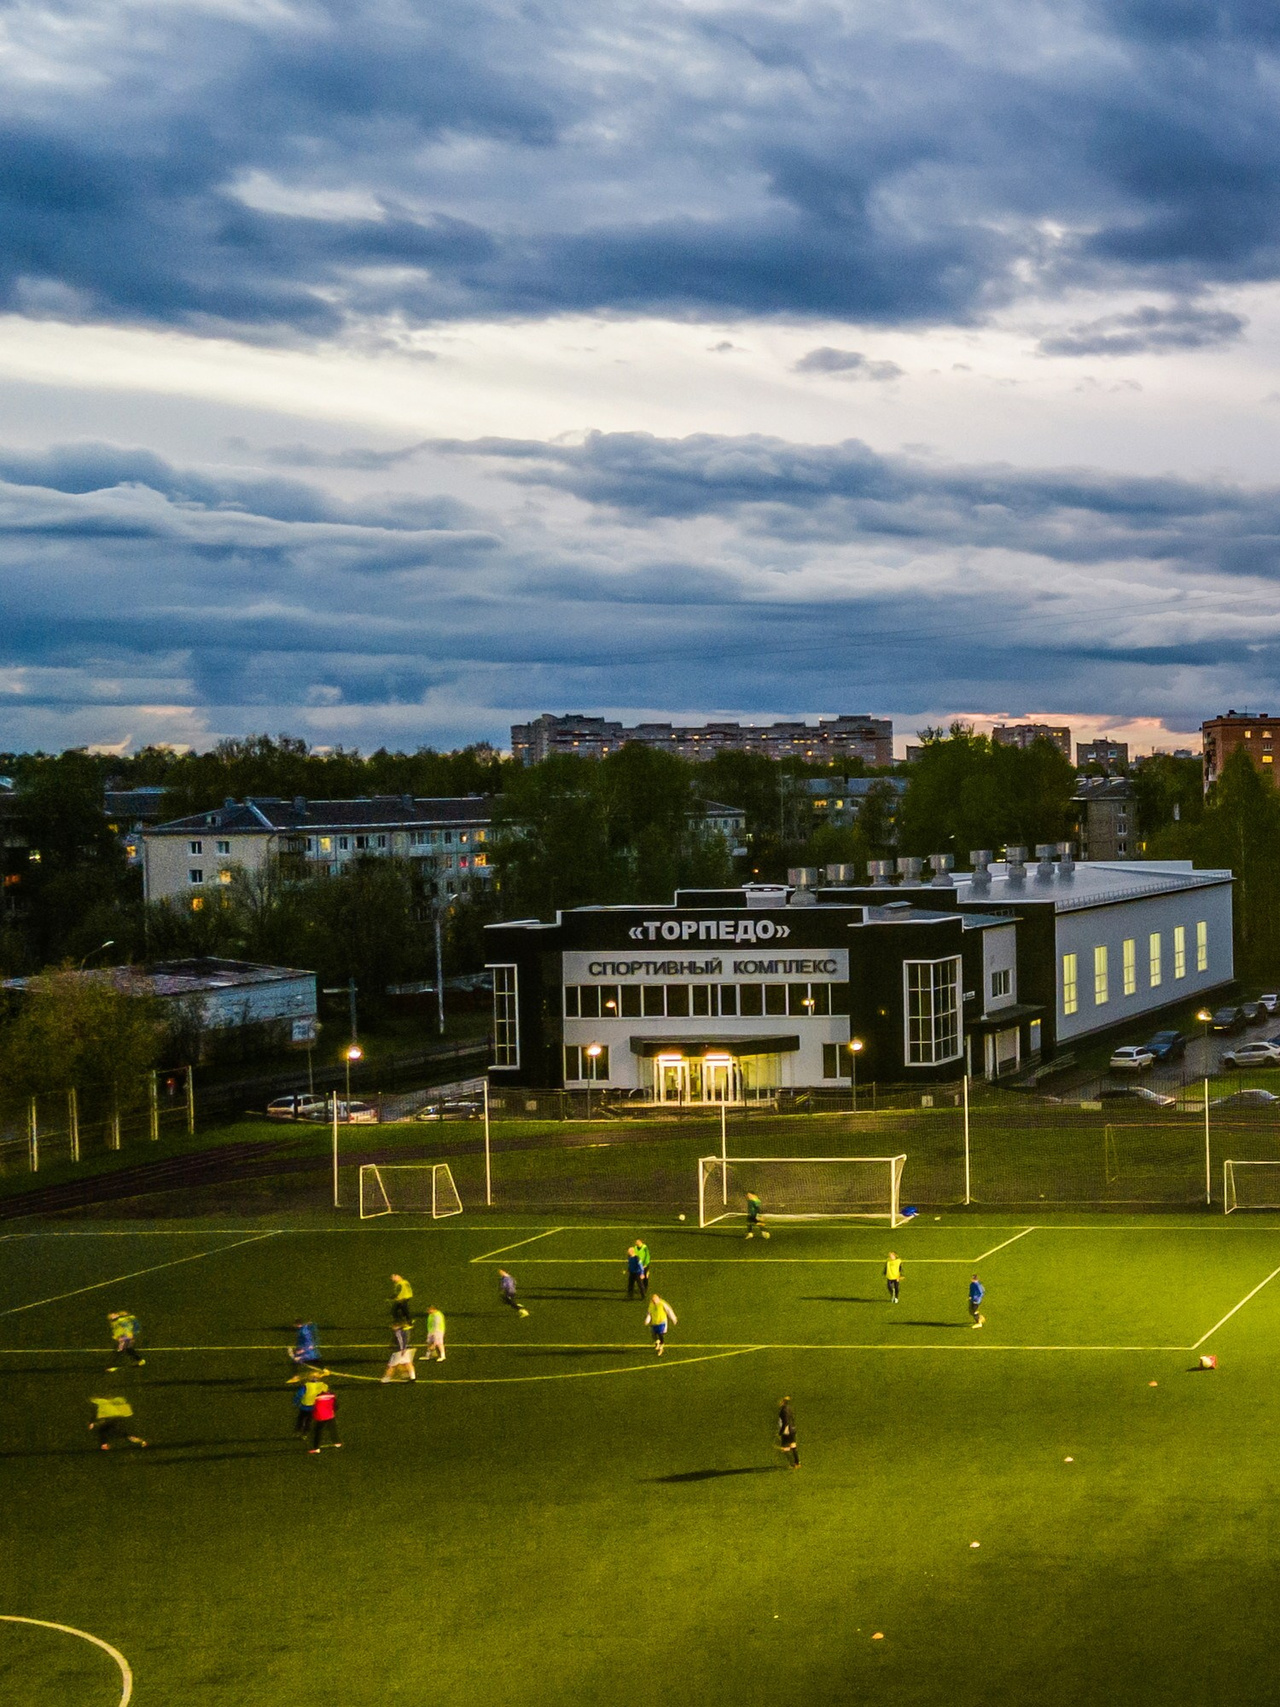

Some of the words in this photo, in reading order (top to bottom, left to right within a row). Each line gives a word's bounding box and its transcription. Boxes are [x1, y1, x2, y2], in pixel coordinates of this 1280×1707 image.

[628, 920, 791, 943] «ТОРПЕДО»
[588, 957, 723, 976] СПОРТИВНЫЙ
[733, 959, 837, 975] КОМПЛЕКС
